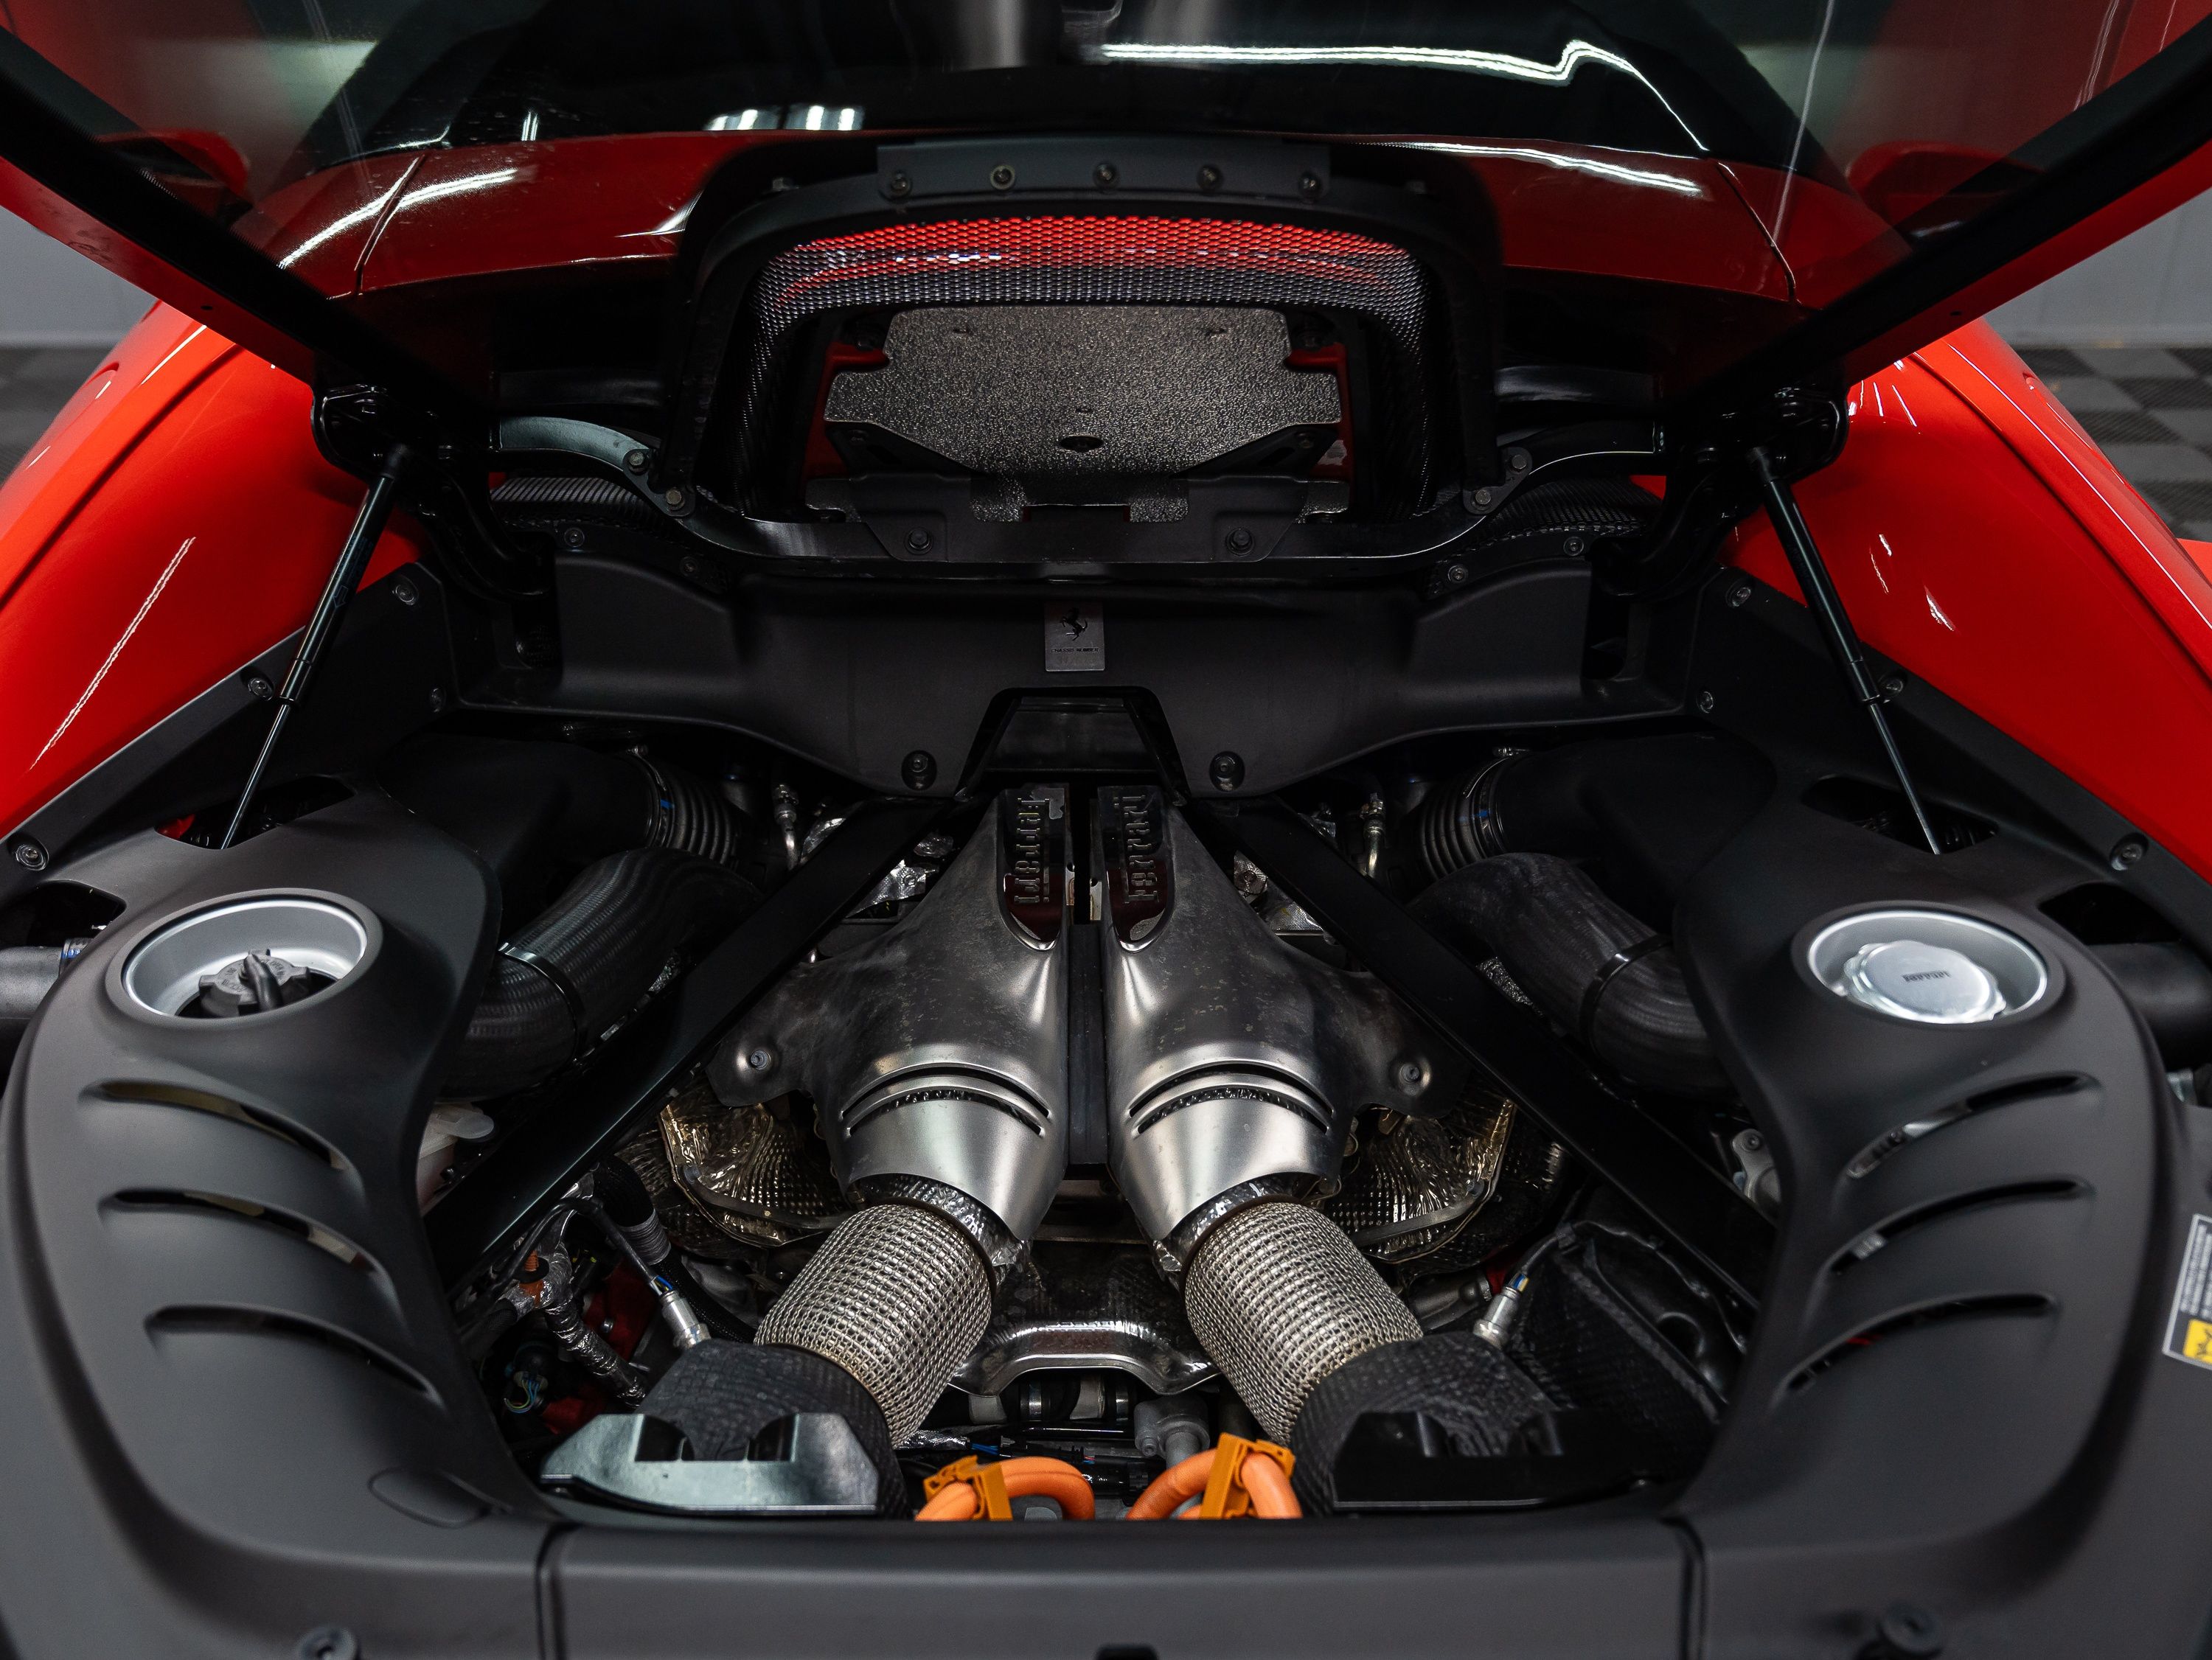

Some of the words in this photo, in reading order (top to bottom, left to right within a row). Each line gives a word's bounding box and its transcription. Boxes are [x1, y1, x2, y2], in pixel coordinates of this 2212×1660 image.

[1013, 797, 1050, 904] Ferrari
[1113, 795, 1160, 904] Ferrari
[1902, 970, 1952, 983] Ferrari
